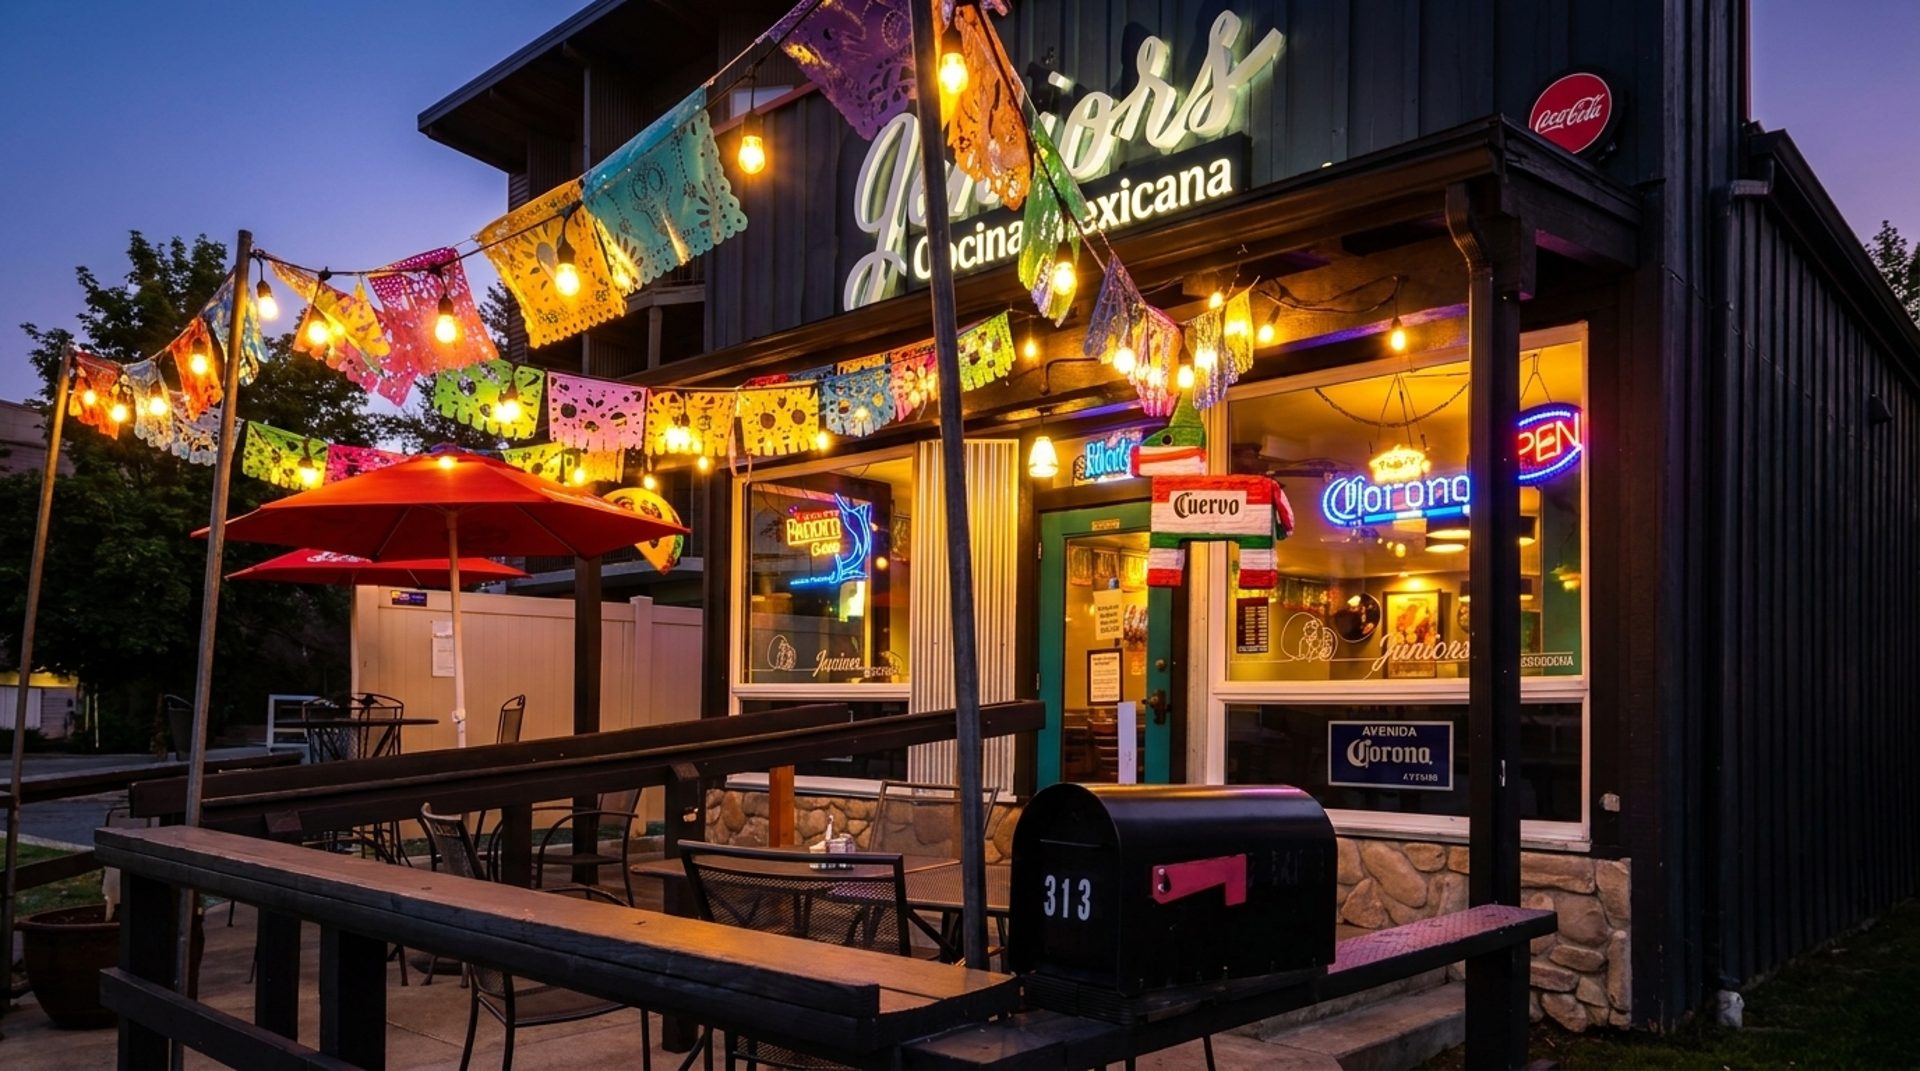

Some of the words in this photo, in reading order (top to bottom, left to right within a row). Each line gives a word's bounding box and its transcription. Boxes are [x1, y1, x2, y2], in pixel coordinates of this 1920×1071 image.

[1519, 412, 1579, 462] PEN
[1173, 491, 1239, 519] Cuervo
[1323, 475, 1470, 527] Corona
[1362, 726, 1417, 737] AVENIDA
[1043, 874, 1091, 921] 313
